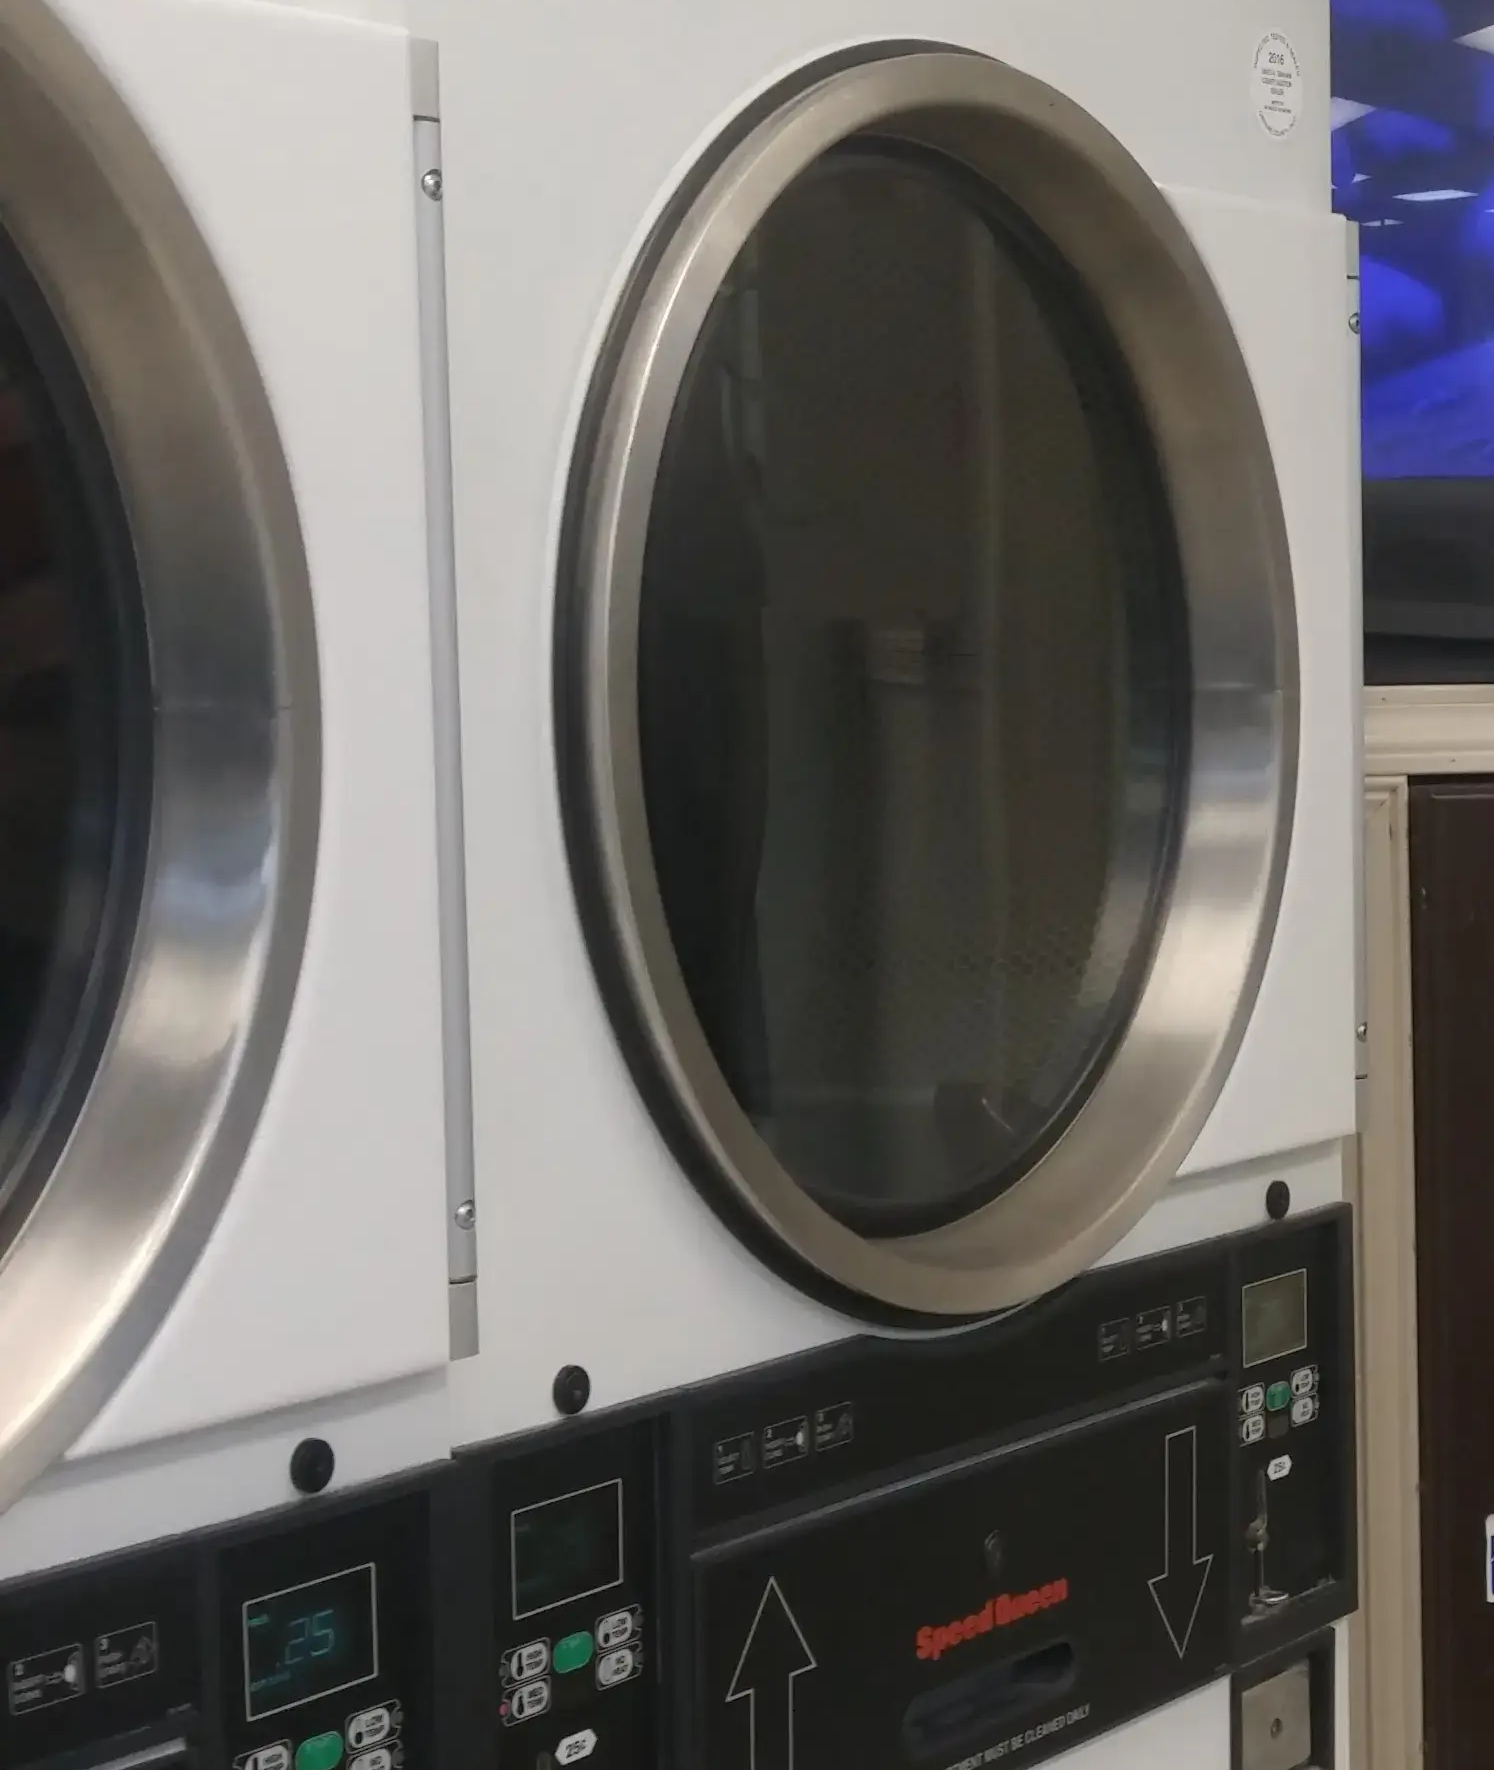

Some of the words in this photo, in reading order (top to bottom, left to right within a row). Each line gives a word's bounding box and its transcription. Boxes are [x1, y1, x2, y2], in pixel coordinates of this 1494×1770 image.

[916, 1600, 994, 1660] Speed
[984, 1739, 1011, 1763] MUST
[1011, 1733, 1025, 1752] BE
[1024, 1716, 1066, 1745] CLEANED
[1066, 1703, 1091, 1724] DAILY
